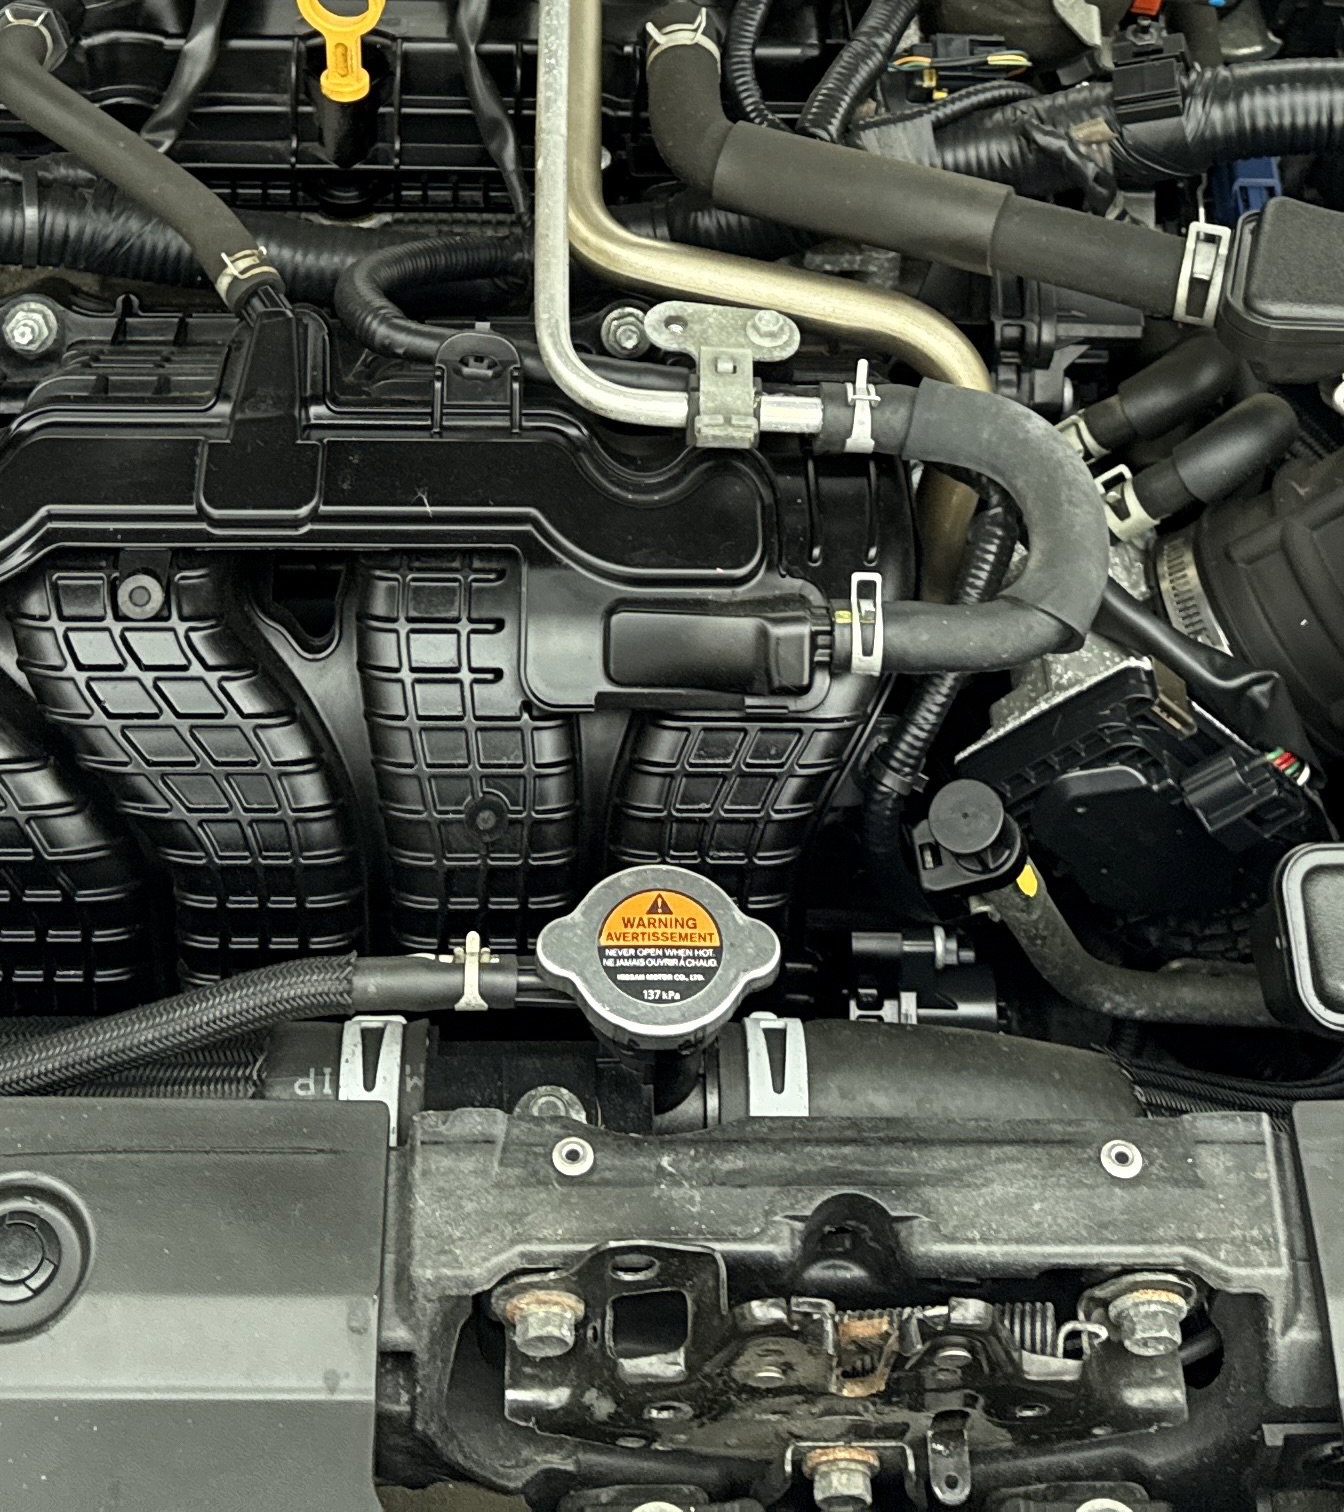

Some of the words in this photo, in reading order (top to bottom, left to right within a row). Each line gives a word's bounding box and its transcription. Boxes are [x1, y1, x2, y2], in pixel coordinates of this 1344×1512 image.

[622, 917, 698, 930] WARNING
[606, 931, 715, 944] AVERTISSEMENT
[605, 948, 636, 957] NEVER
[637, 948, 663, 957] OPEN
[664, 948, 693, 957] WHEN
[603, 958, 615, 967] NE
[615, 958, 646, 967] JAMAIS
[646, 958, 679, 967] OUVRIR
[642, 989, 661, 1000] 137
[662, 990, 681, 1000] kPa
